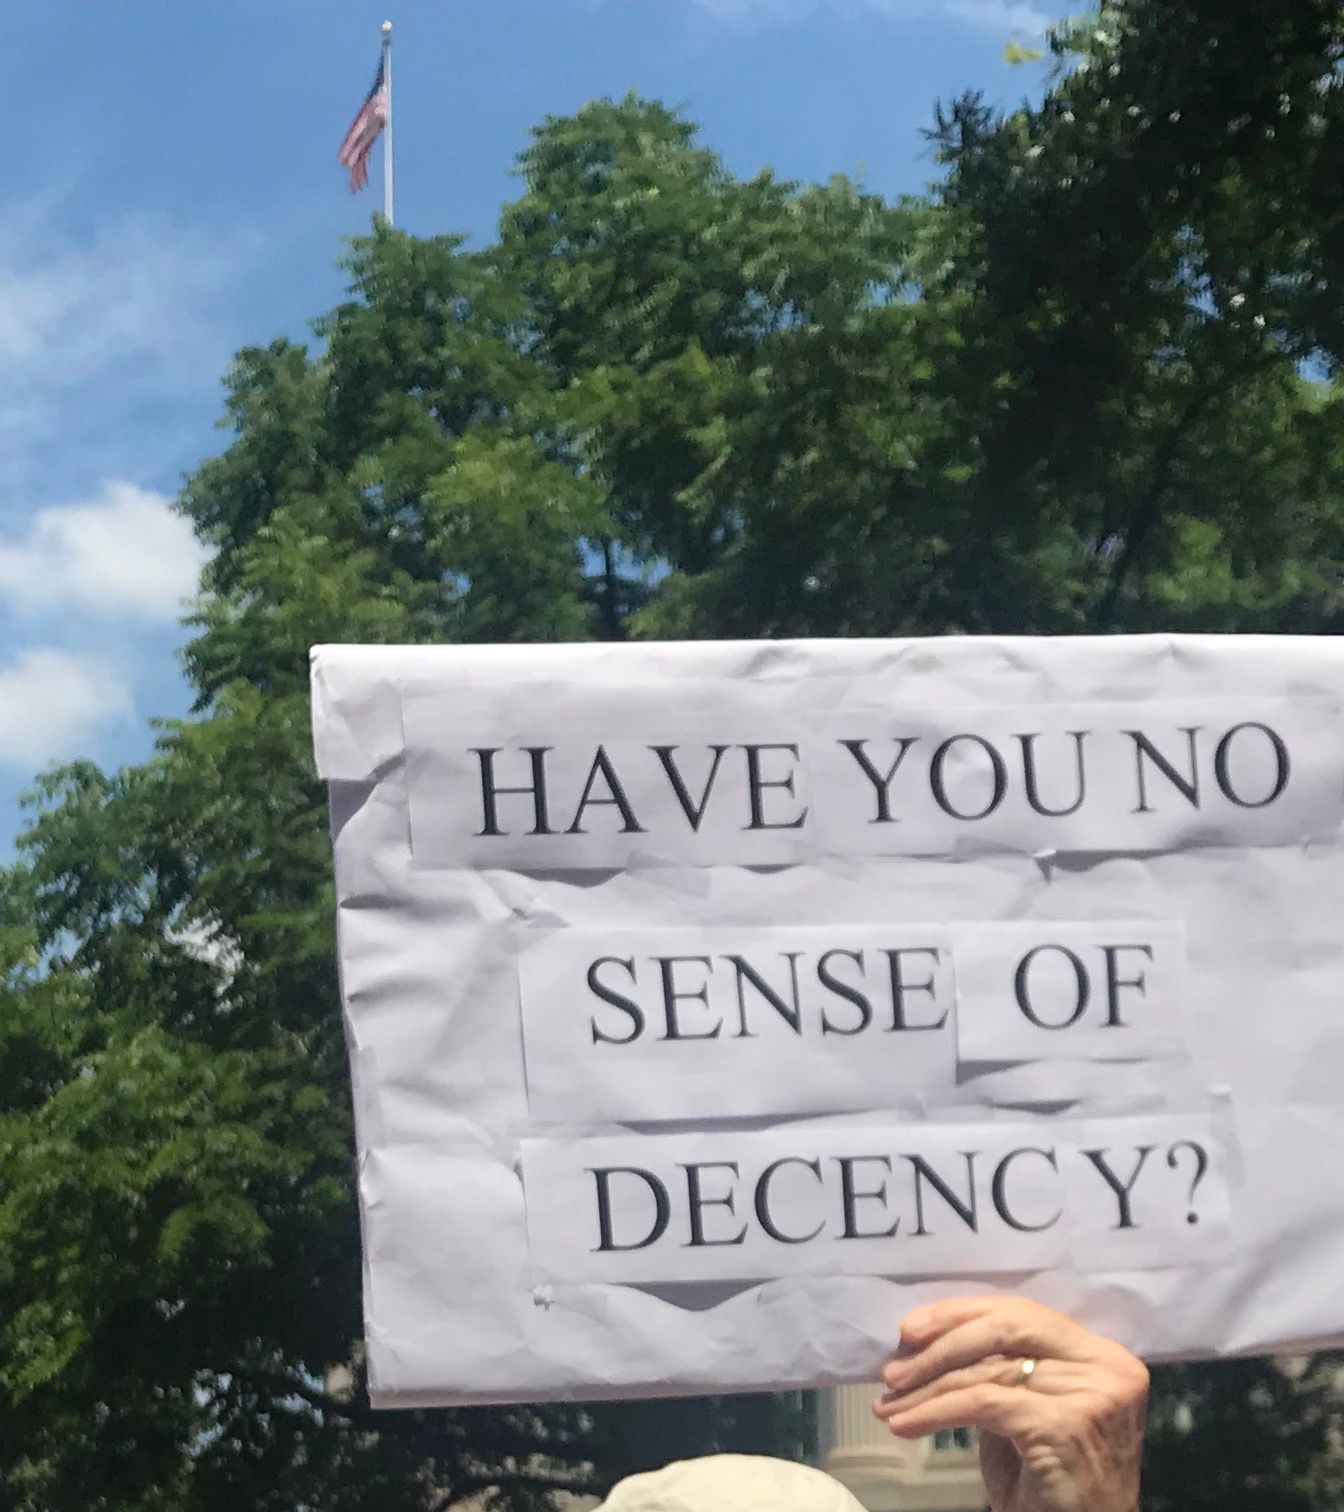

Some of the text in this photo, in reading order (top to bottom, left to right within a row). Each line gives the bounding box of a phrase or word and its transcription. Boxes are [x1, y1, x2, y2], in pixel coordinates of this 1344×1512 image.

[472, 719, 1293, 839] HAVE YOU NO
[585, 940, 1156, 1046] SENSE OF
[588, 1138, 1211, 1253] DECENCY?
